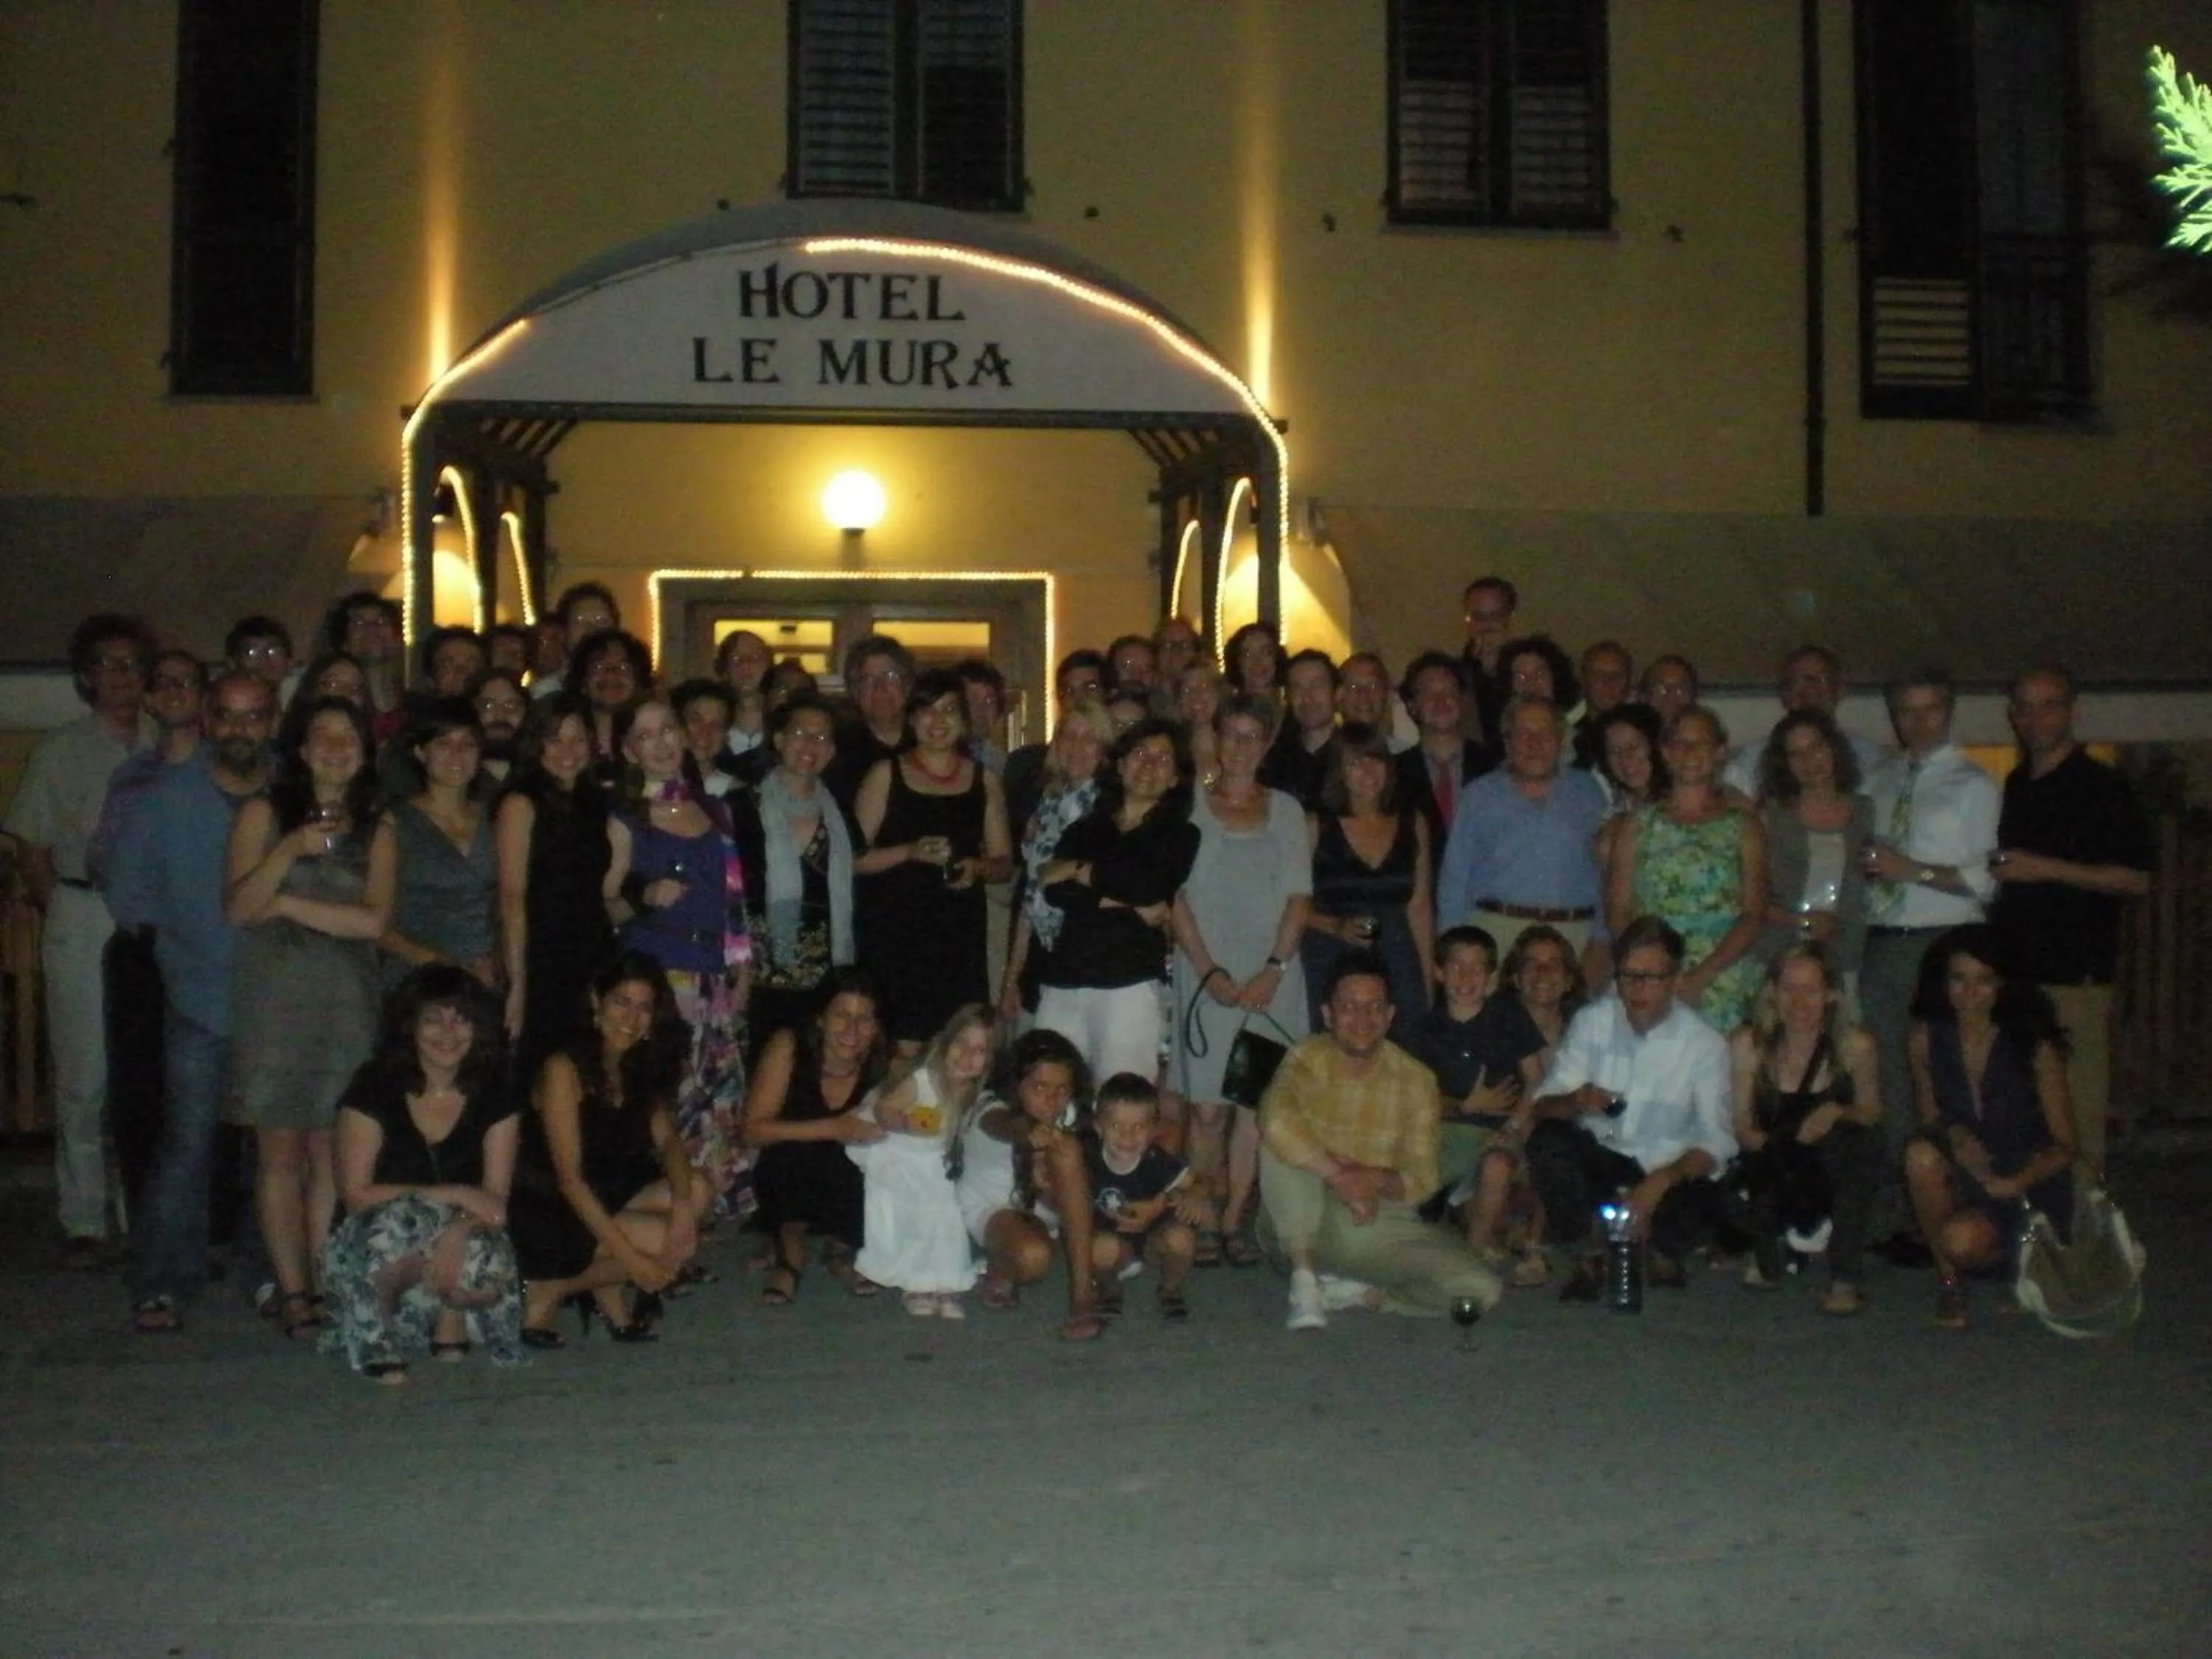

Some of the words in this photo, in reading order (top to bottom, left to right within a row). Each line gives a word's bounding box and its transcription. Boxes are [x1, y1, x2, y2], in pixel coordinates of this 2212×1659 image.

[740, 261, 966, 321] HOTEL
[693, 337, 780, 383] LE
[818, 339, 1012, 389] MURA
